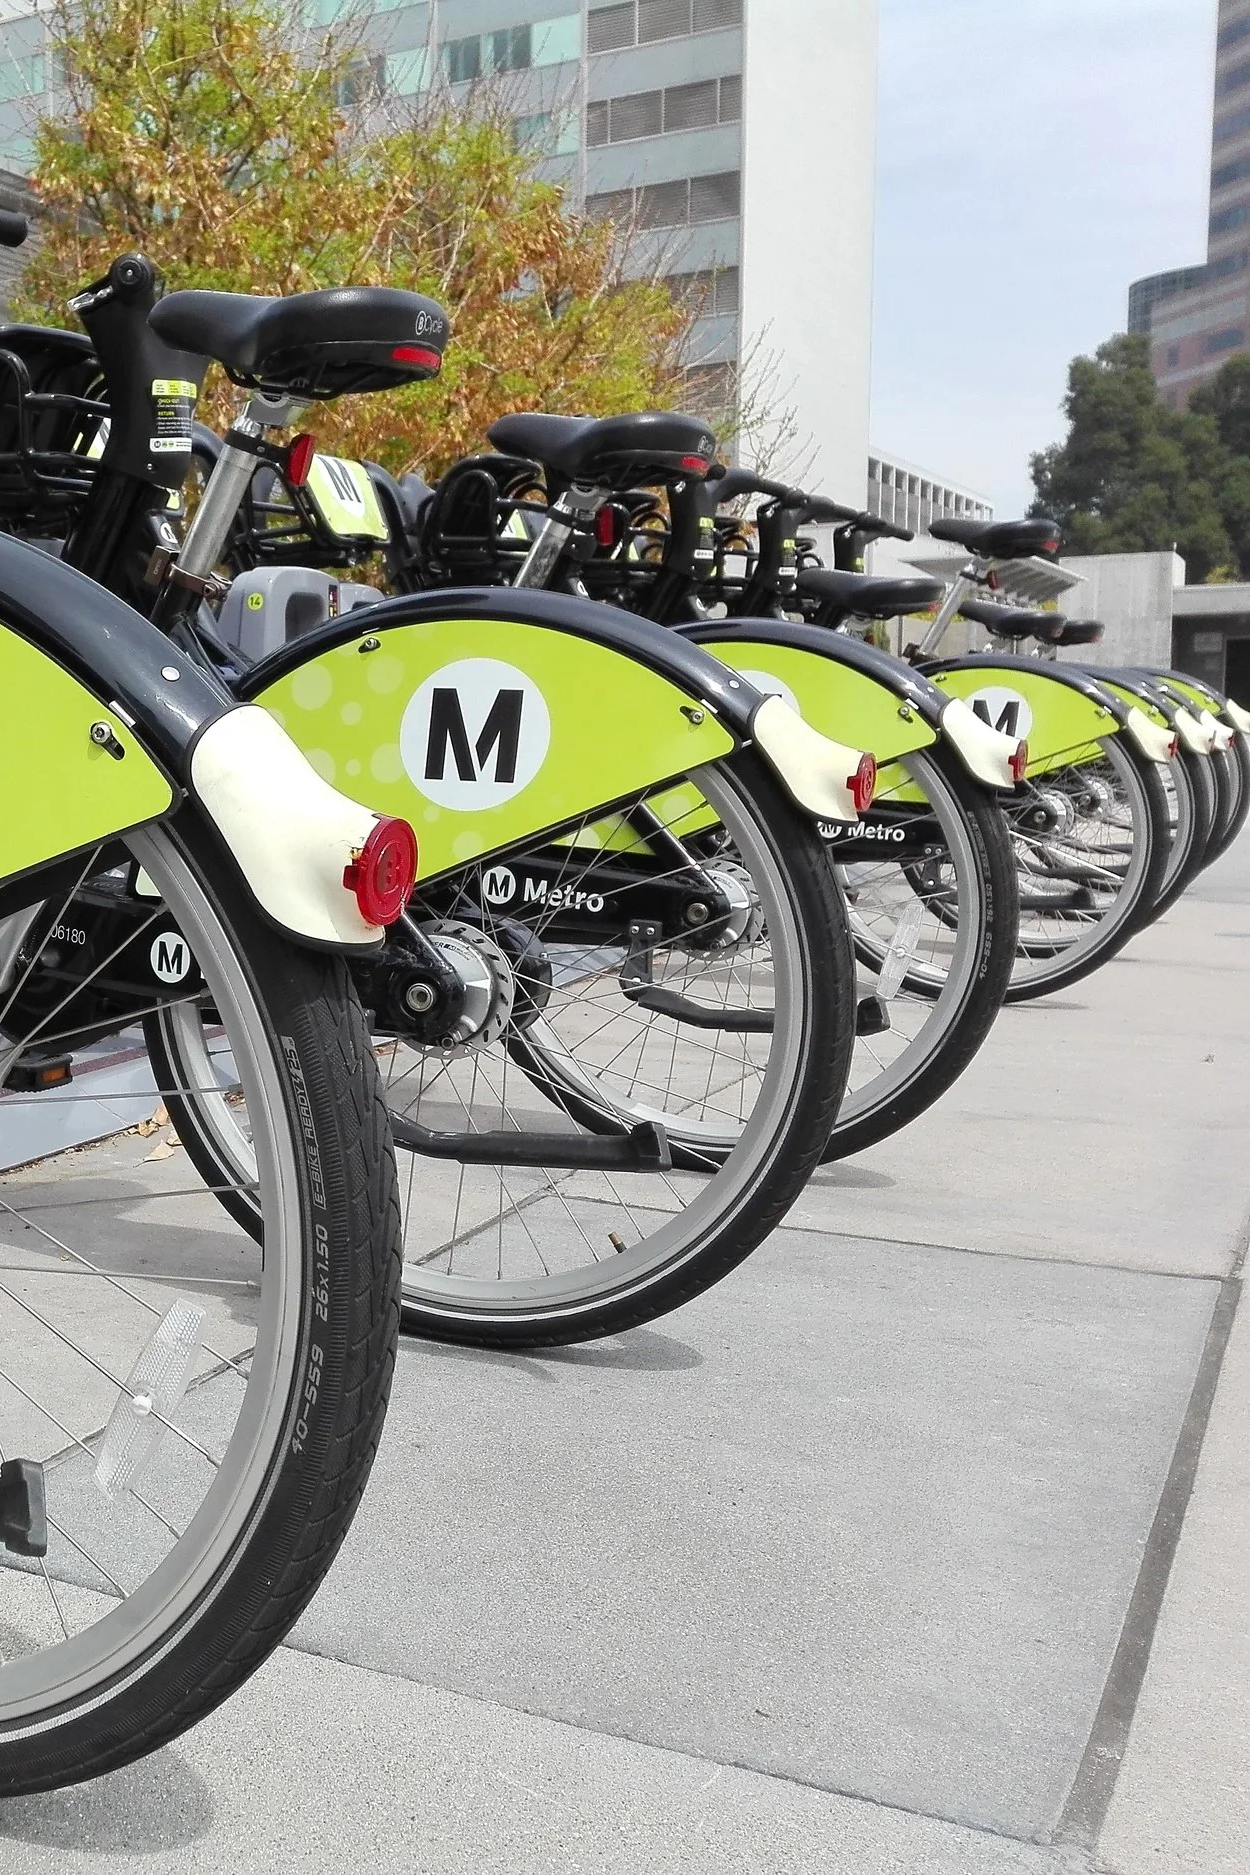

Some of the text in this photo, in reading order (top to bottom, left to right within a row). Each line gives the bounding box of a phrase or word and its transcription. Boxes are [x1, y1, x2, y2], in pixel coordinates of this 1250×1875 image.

[317, 456, 362, 503] M
[250, 596, 261, 607] 14
[424, 687, 524, 784] M
[848, 821, 906, 842] Metro
[488, 872, 605, 913] M Metro
[157, 941, 184, 976] M
[286, 1047, 301, 1070] 25
[295, 1084, 315, 1139] READY
[308, 1145, 325, 1205] E-BIKE
[291, 1223, 329, 1454] 40-559 26x1.50
